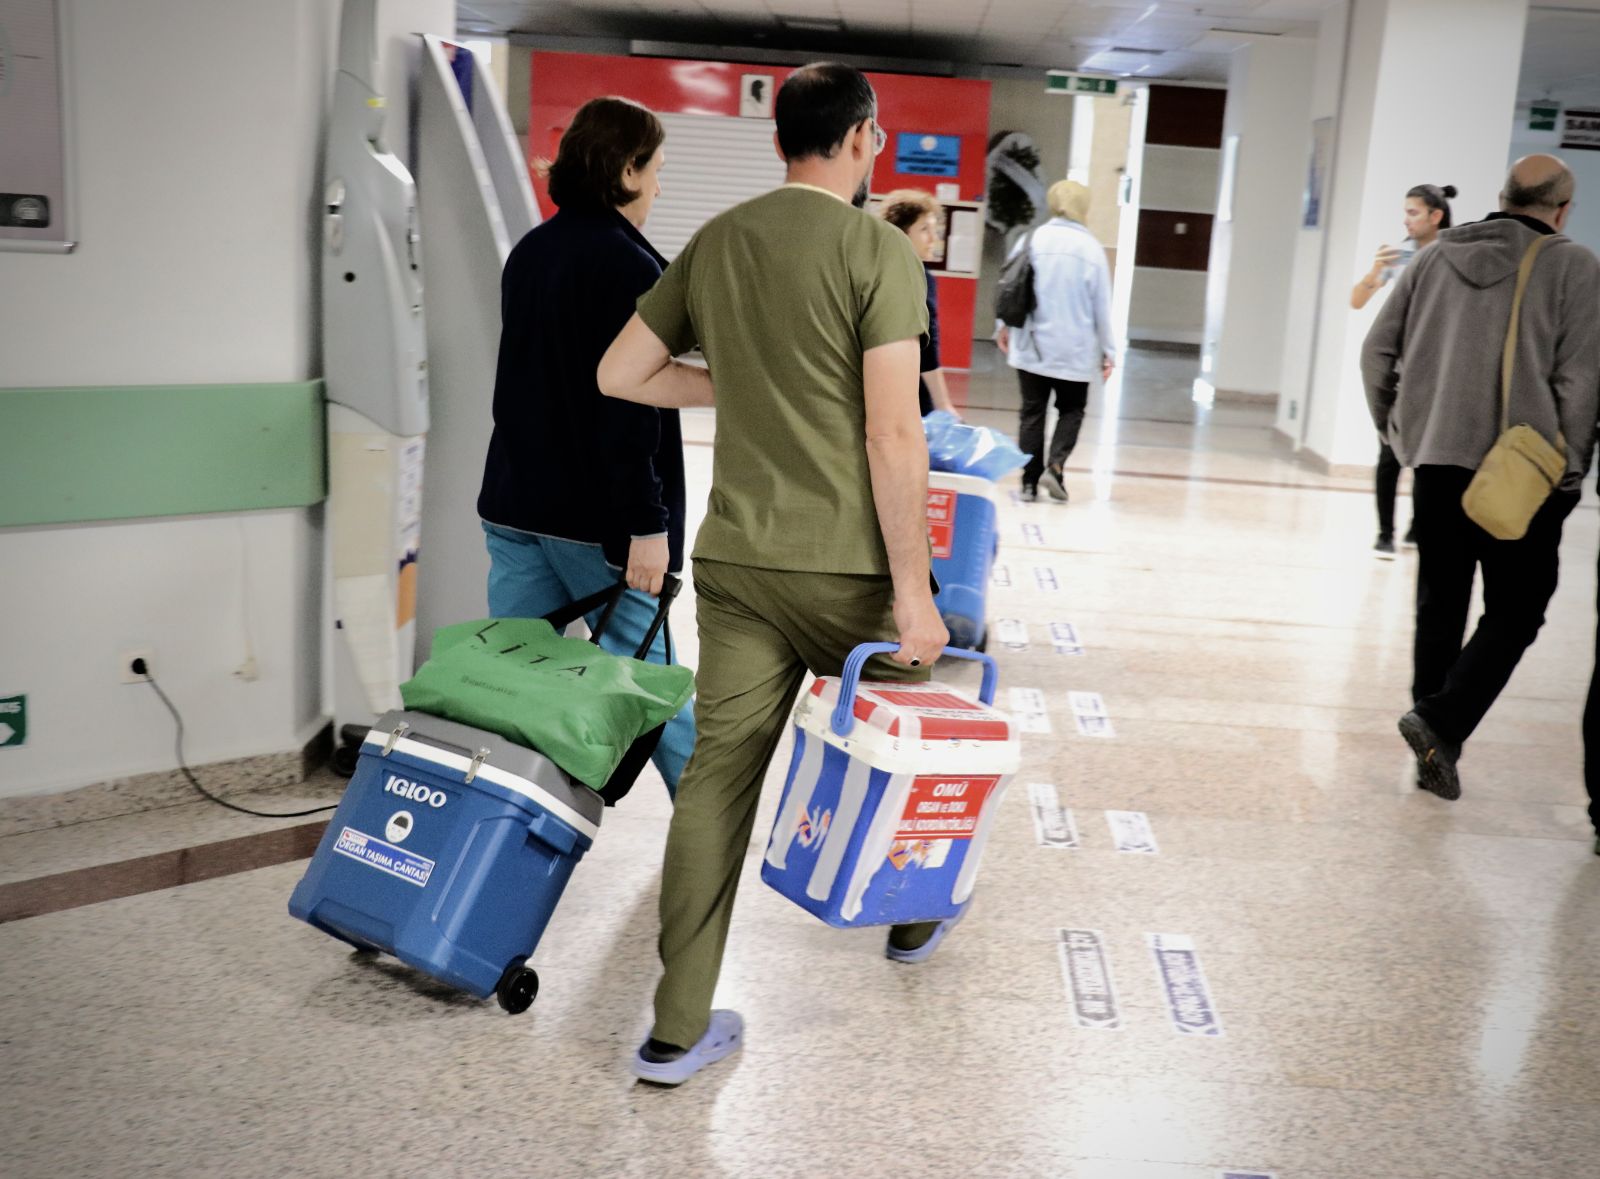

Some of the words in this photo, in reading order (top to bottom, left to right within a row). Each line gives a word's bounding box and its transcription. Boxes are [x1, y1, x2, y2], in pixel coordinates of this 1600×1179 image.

[385, 776, 447, 808] IGLOO
[932, 781, 969, 797] OMÜ
[338, 840, 366, 856] ORGAN
[366, 848, 393, 868] TAŞIMA
